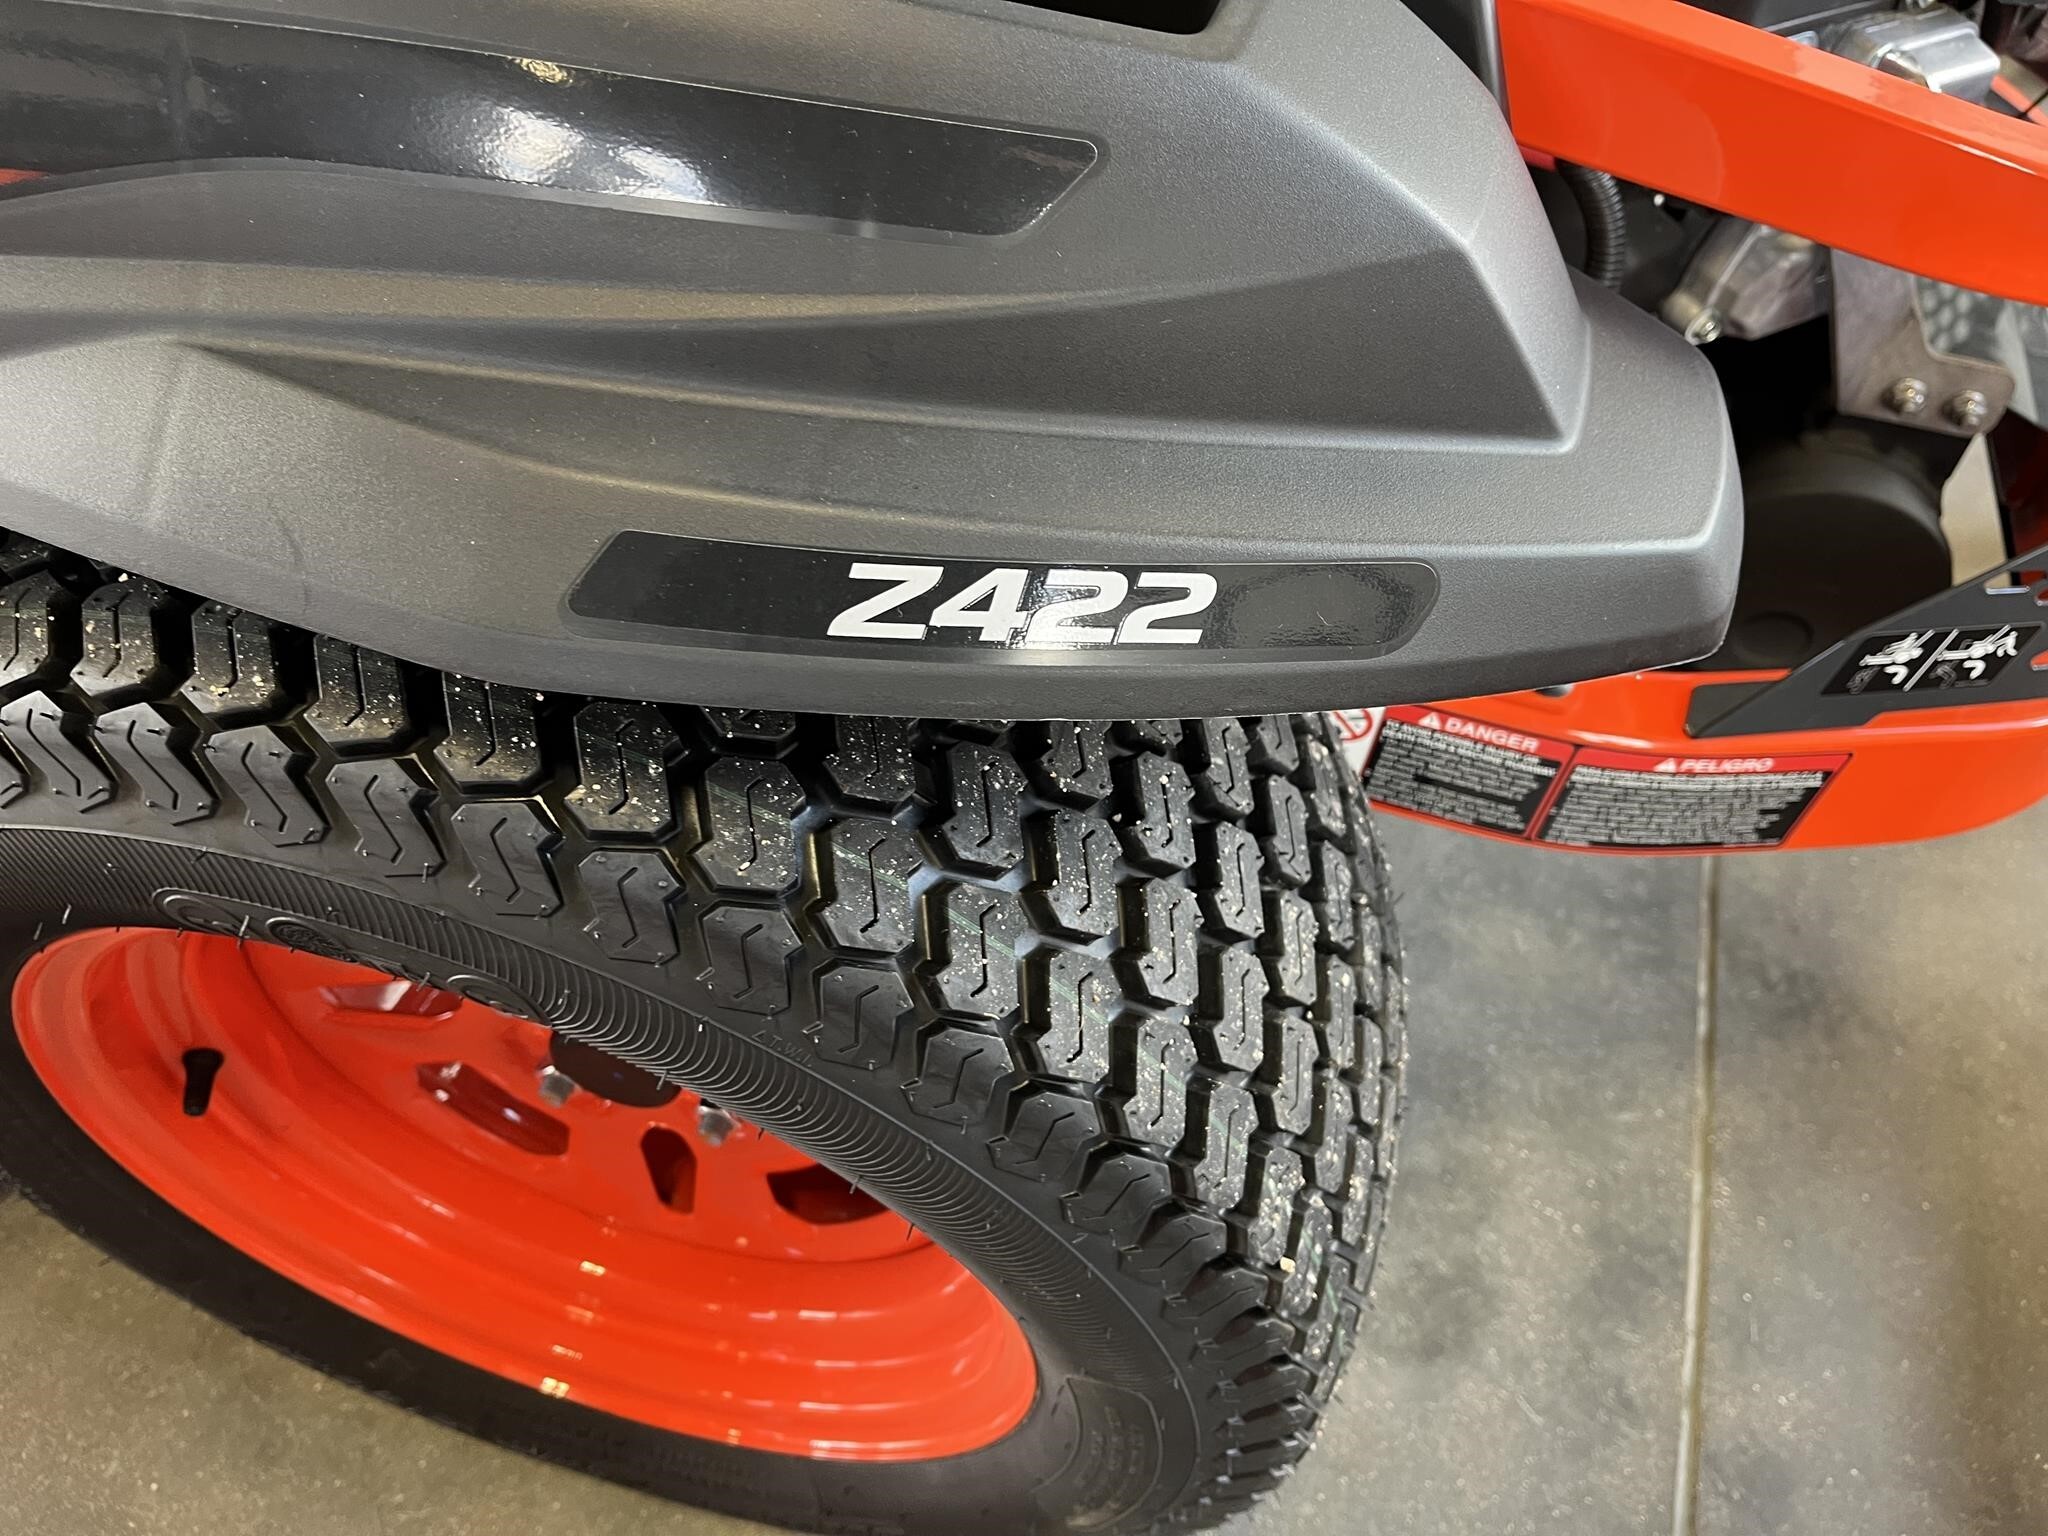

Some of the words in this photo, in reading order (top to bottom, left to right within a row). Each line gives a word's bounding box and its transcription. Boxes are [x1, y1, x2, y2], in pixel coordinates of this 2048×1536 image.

[827, 562, 1219, 646] Z422
[1445, 717, 1540, 753] DANGER
[1679, 758, 1775, 773] PELIGRO
